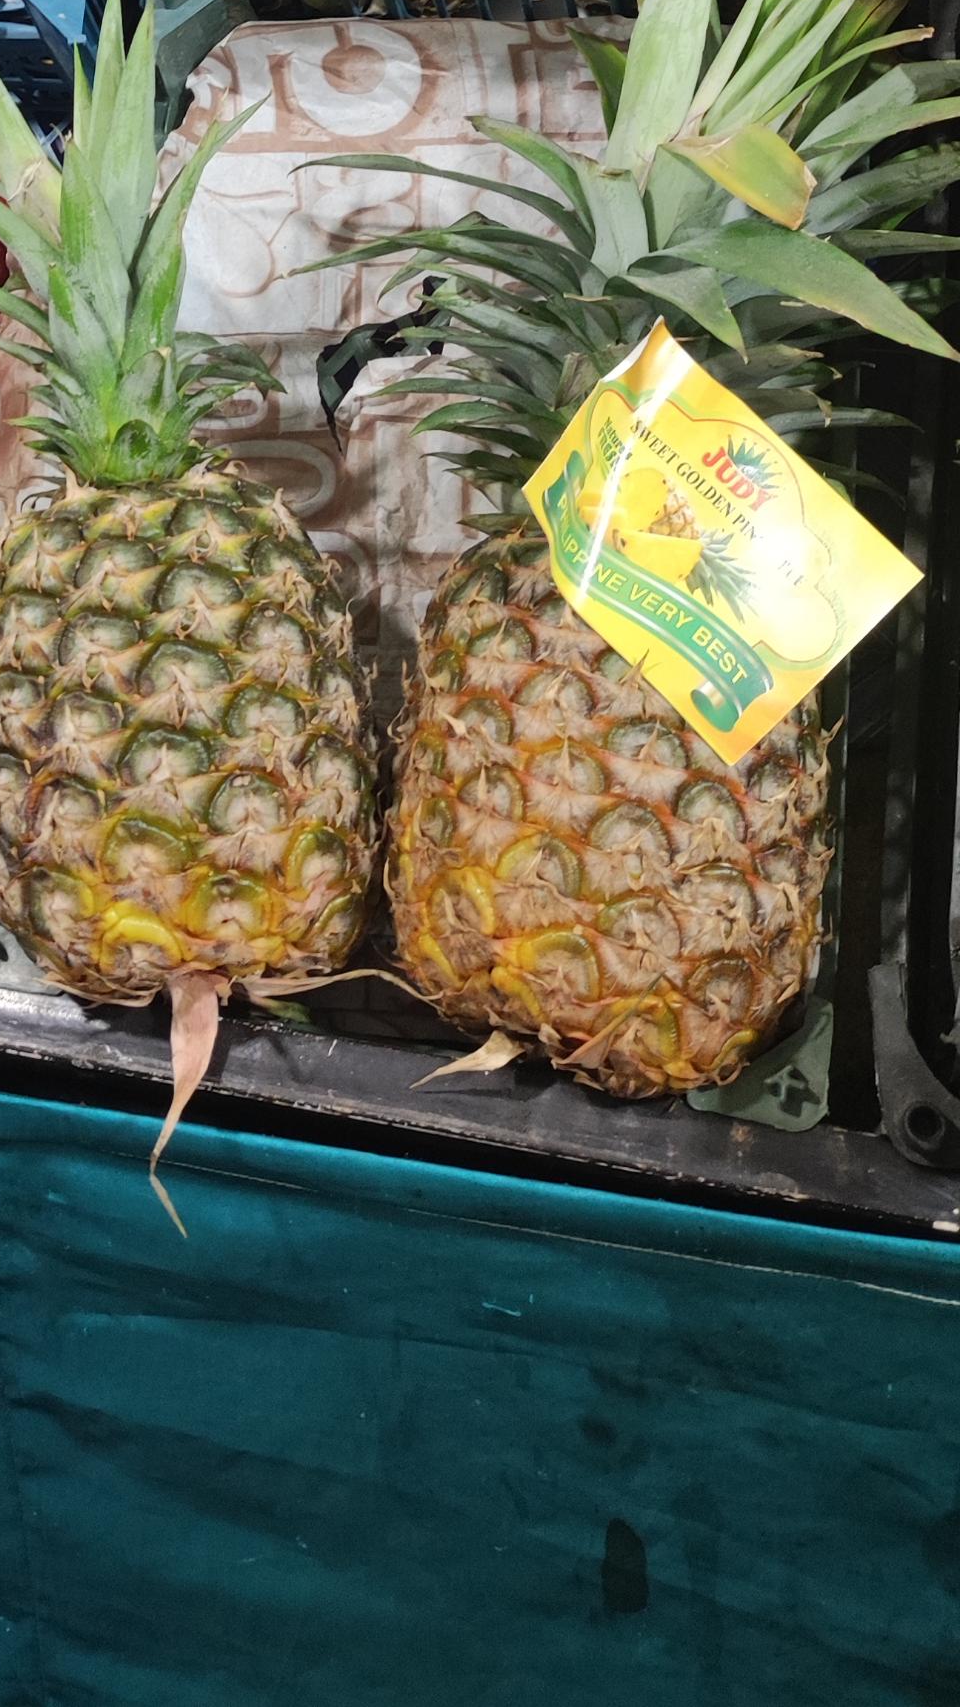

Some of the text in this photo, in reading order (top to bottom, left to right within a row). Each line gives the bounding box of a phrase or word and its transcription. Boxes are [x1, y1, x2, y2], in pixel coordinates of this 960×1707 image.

[630, 420, 680, 465] SWEET
[676, 461, 735, 518] GOLDEN
[701, 446, 777, 511] JUDY
[557, 493, 750, 685] PHILIPPNE VERY BEST
